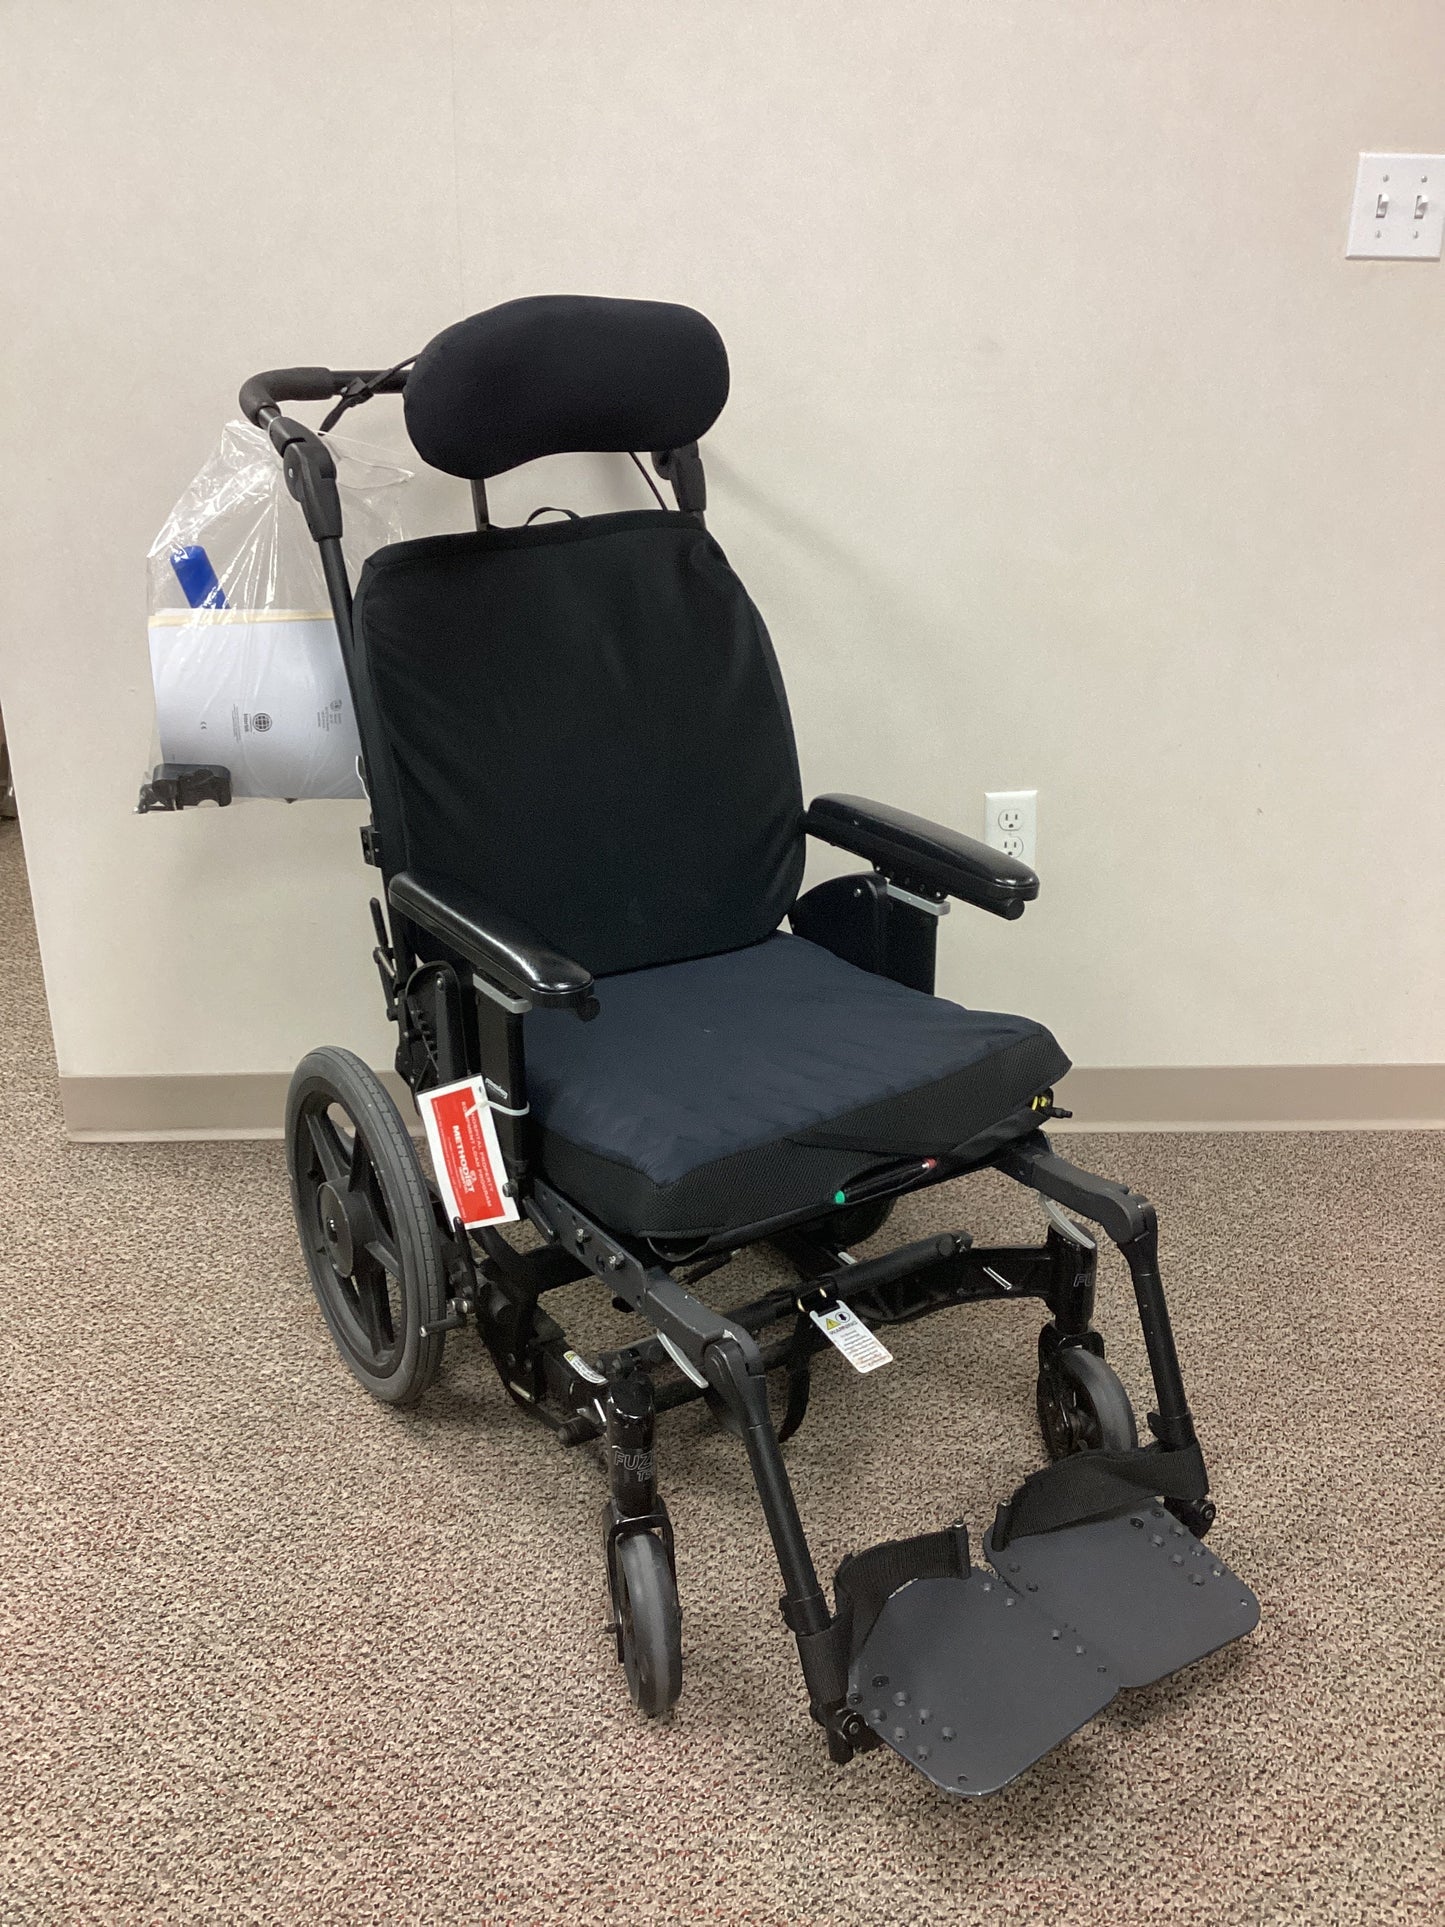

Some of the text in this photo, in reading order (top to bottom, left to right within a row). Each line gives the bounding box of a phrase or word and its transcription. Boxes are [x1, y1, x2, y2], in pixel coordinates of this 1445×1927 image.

[452, 1125, 475, 1193] METHODIST
[461, 1101, 493, 1207] EQPMENT LOAN PROGRAM
[470, 1112, 494, 1193] HOSPITAL PROPERTY
